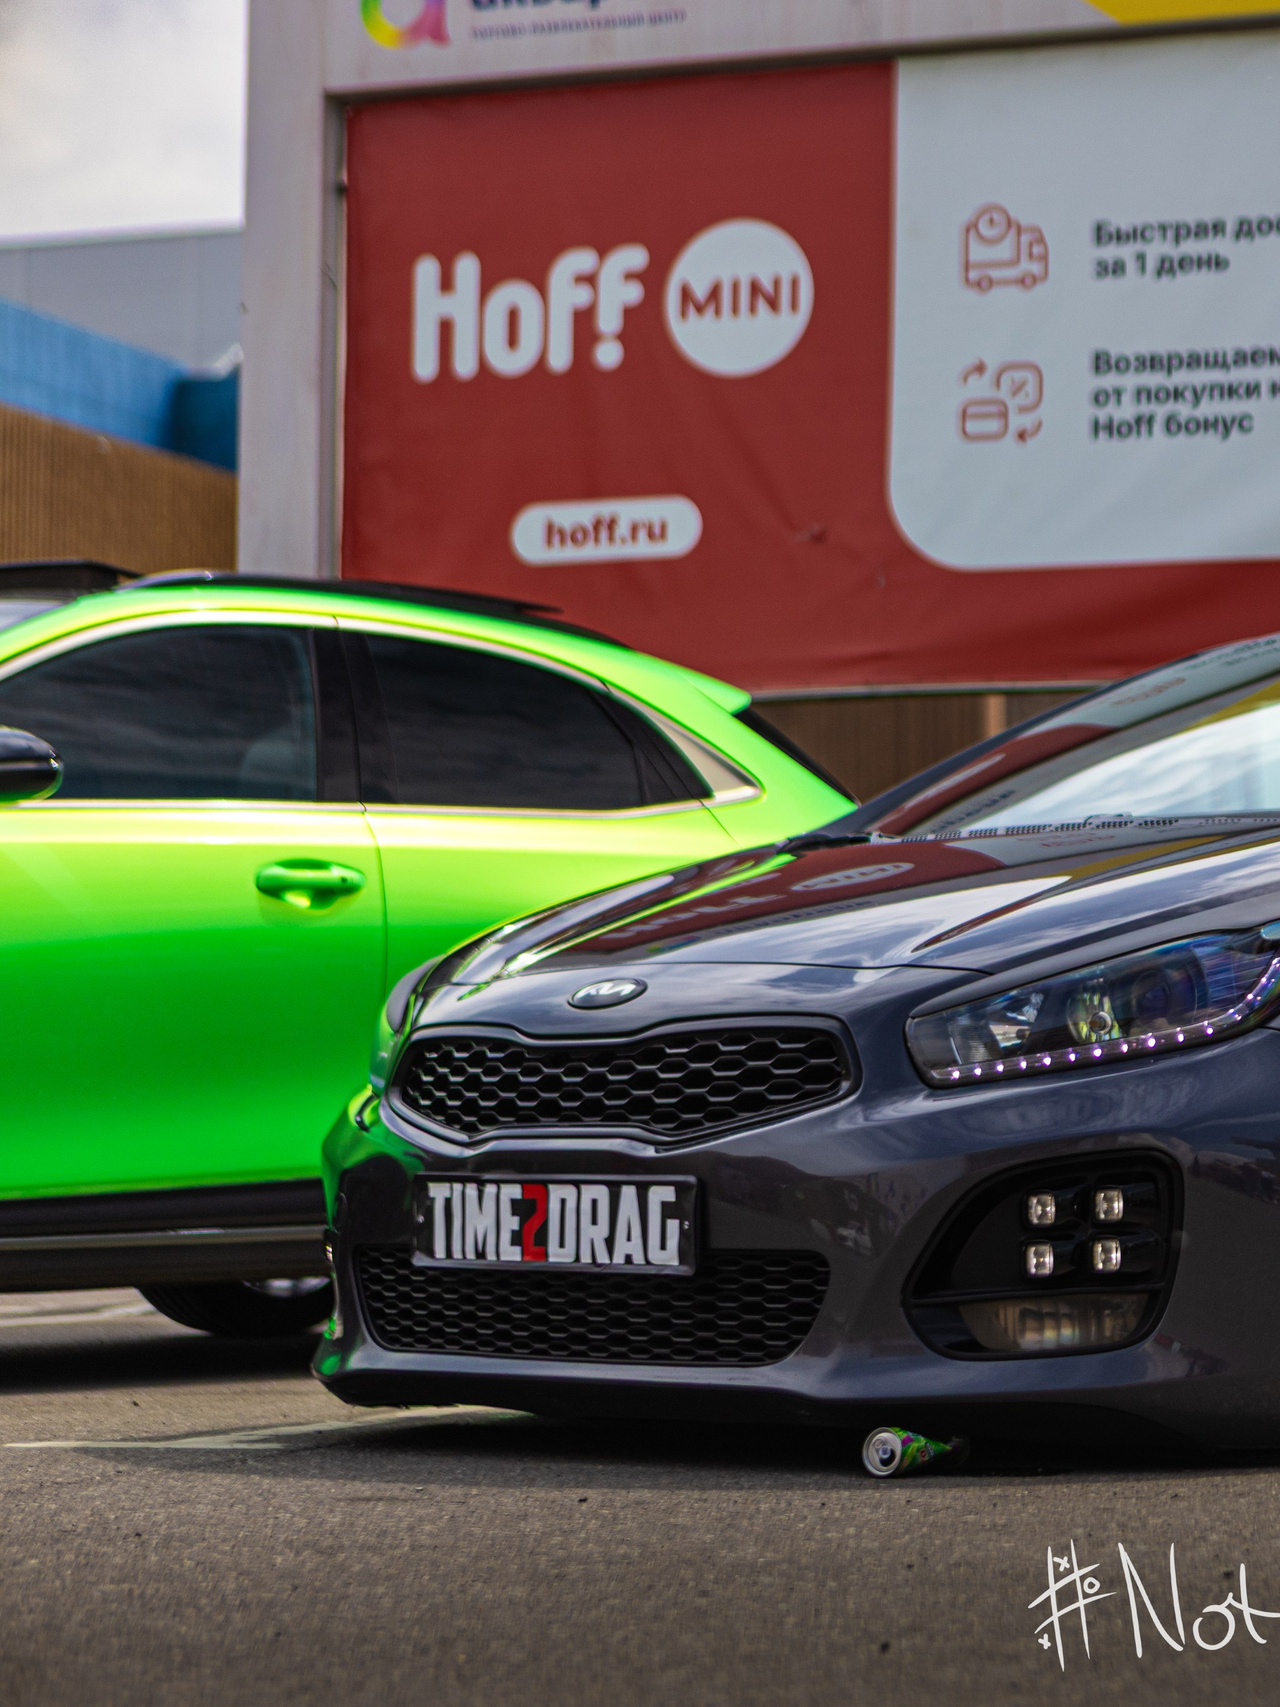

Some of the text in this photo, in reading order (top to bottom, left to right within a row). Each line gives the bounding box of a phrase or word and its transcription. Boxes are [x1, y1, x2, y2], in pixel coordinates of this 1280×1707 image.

[1093, 219, 1228, 249] Быстрая
[1095, 251, 1232, 281] за 1 день
[413, 243, 651, 383] Hoff
[679, 272, 802, 323] MINI
[1092, 387, 1126, 410] от
[1134, 381, 1263, 411] покупки
[1091, 412, 1255, 442] Hoff бонус
[545, 513, 669, 550] hoff.ru
[427, 1181, 681, 1266] TIME2DRAG
